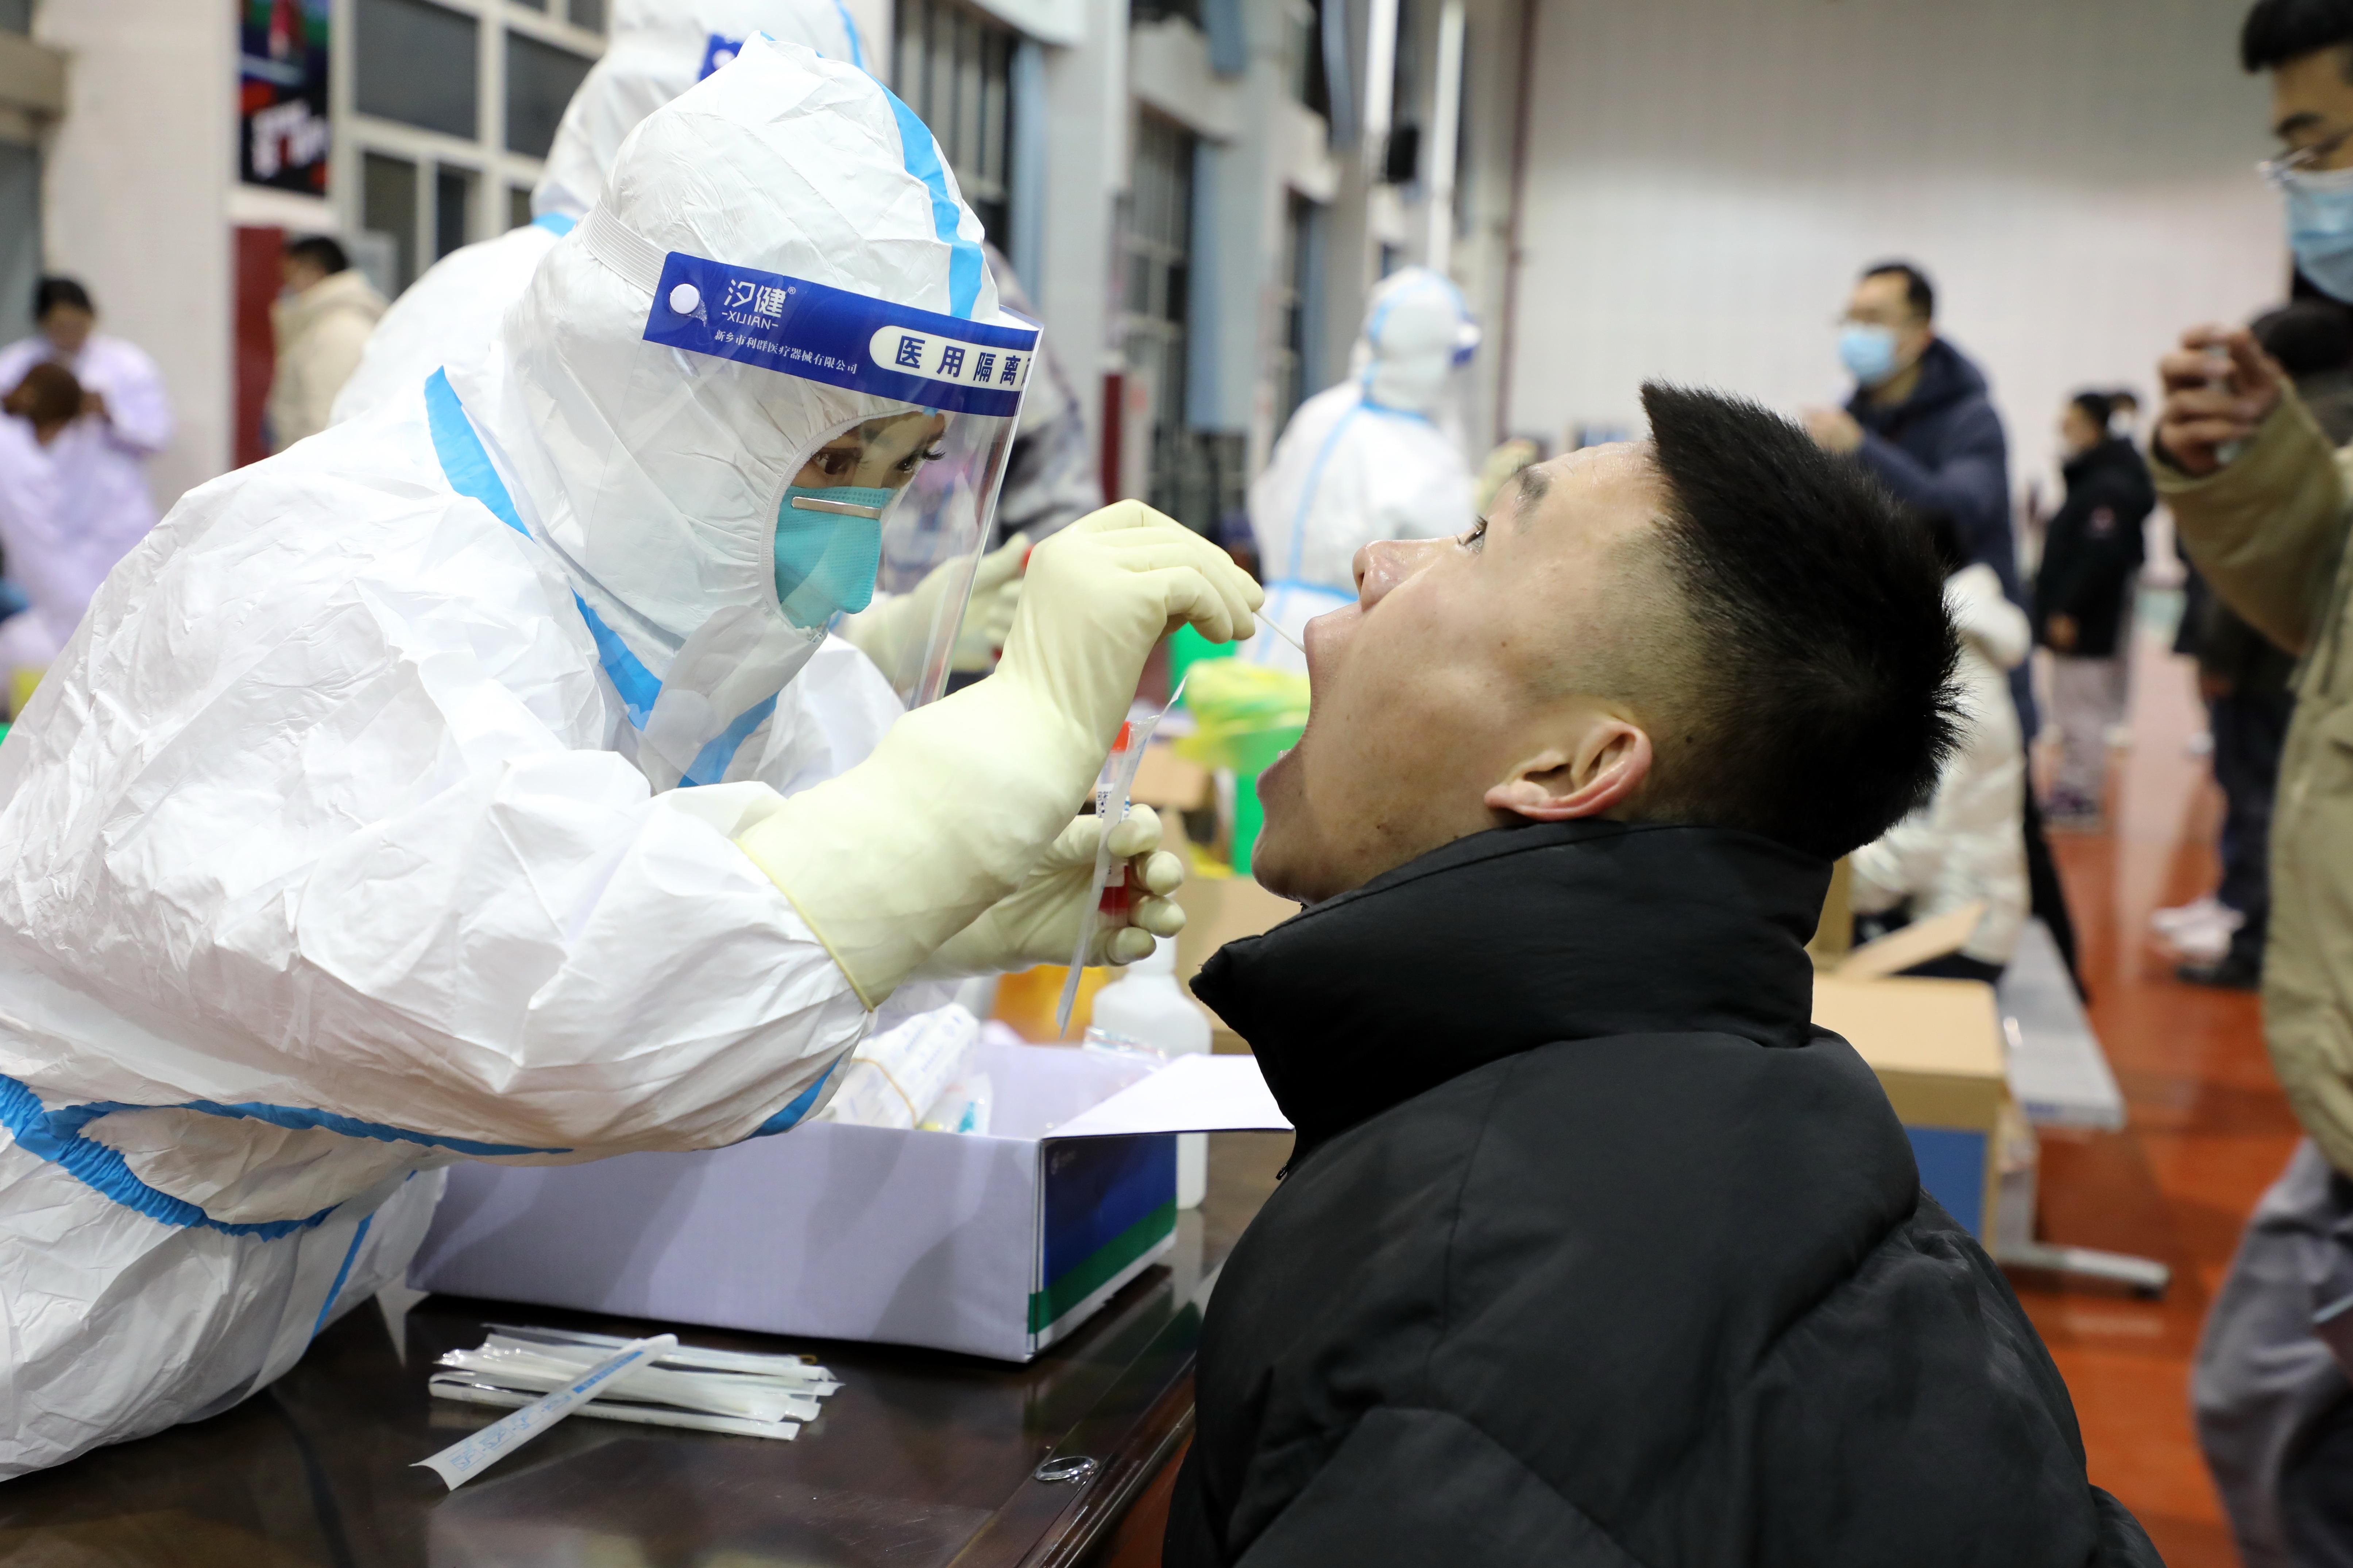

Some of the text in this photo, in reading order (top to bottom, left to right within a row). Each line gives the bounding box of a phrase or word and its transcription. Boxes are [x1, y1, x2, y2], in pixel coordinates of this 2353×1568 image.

[714, 329, 858, 375] 新乡市利群医疗器械有限公司
[895, 335, 1031, 386] 医用隔离
